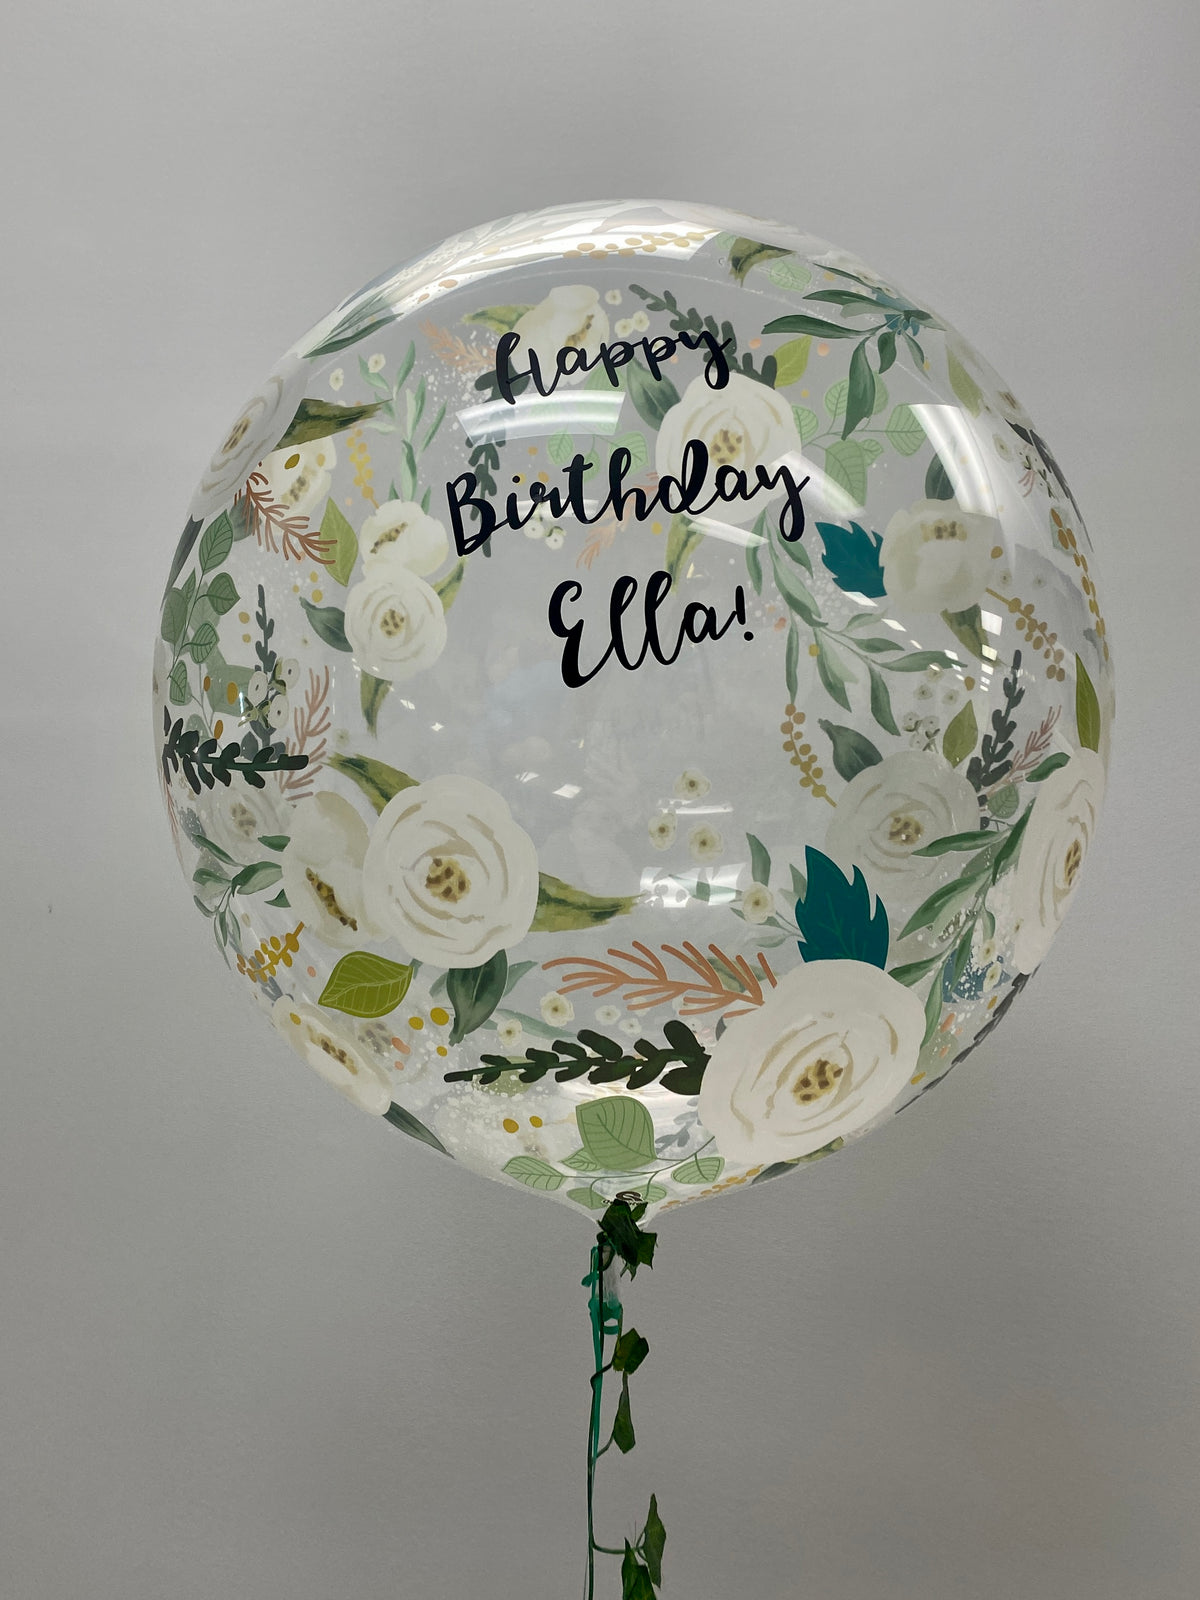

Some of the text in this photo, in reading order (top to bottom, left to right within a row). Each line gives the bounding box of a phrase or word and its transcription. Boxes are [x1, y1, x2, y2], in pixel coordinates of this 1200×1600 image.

[495, 330, 733, 405] Happy
[446, 439, 810, 557] Birthday
[548, 570, 754, 689] Ella!
